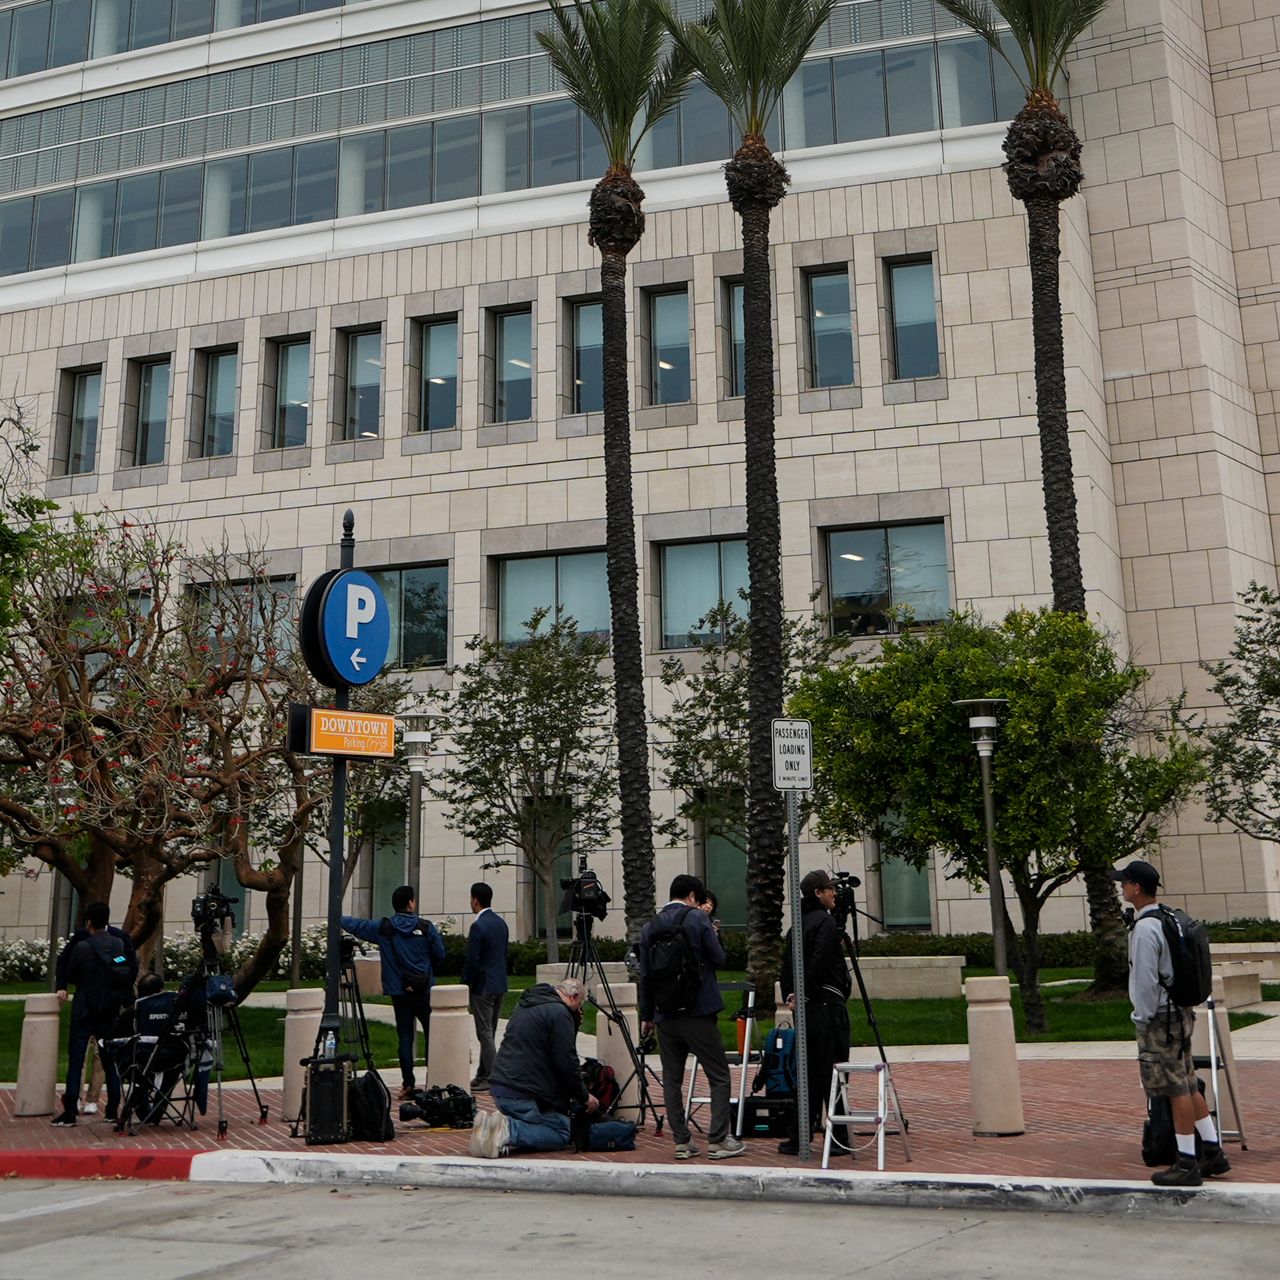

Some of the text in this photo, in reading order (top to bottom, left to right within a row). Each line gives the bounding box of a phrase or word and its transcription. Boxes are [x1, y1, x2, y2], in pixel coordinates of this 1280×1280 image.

[345, 583, 376, 639] P
[320, 717, 388, 736] DOWNTOWN
[775, 728, 808, 739] PASSENGER
[343, 736, 366, 751] Parking
[779, 744, 806, 755] LOADING
[785, 760, 800, 771] ONLY
